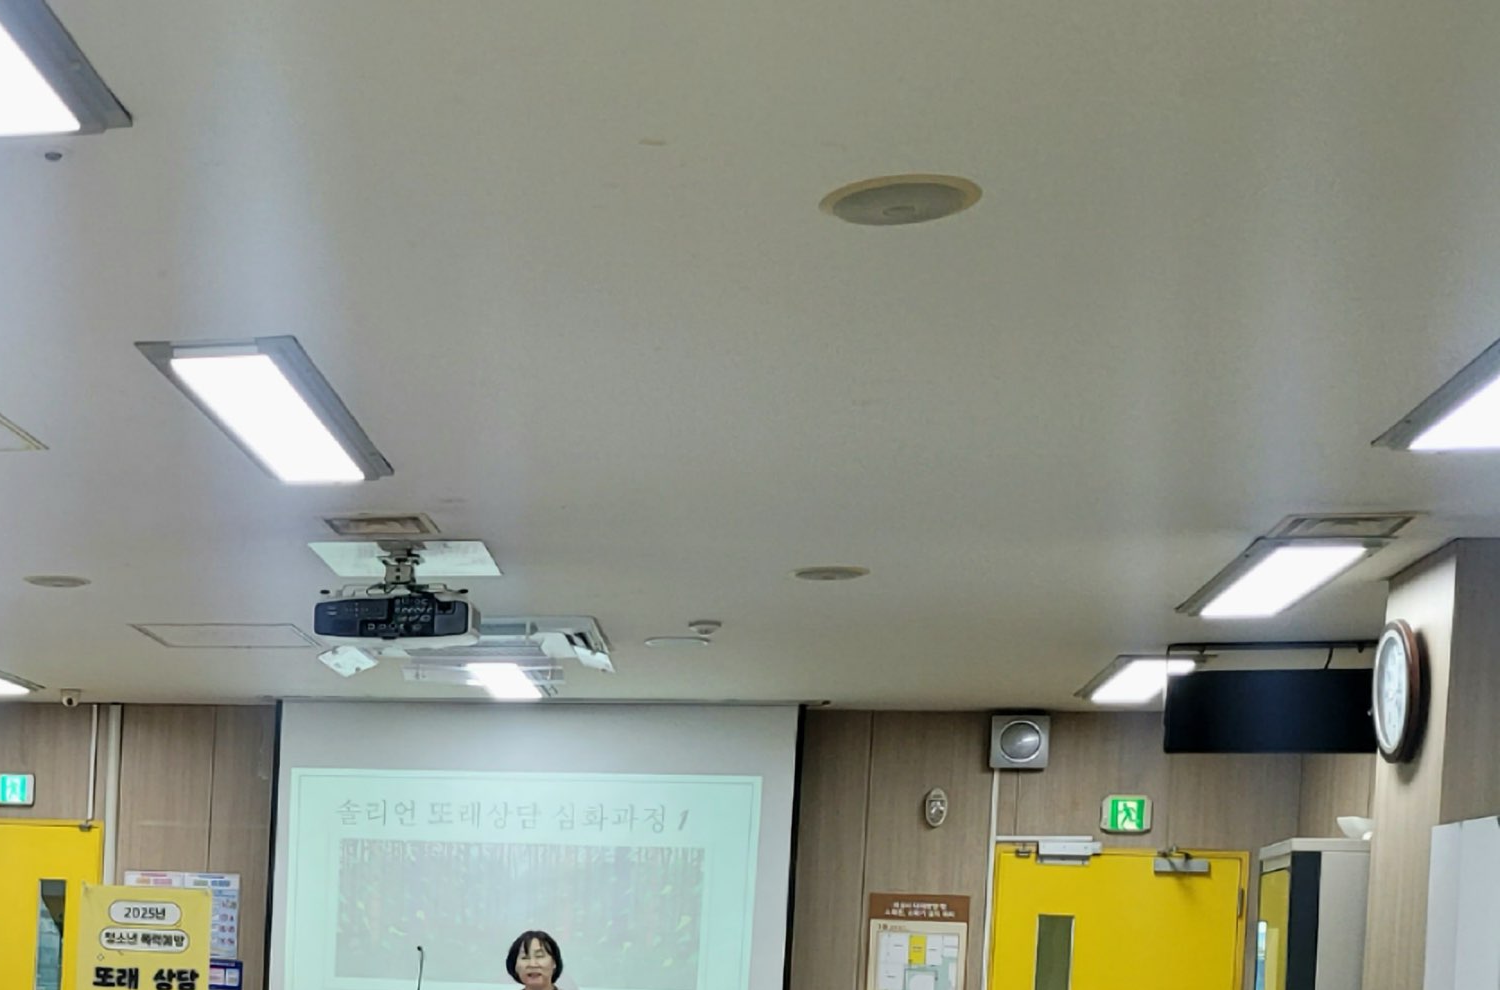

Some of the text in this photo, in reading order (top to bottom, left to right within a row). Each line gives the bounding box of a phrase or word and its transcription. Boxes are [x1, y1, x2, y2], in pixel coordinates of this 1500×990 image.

[337, 799, 417, 827] 솔리언
[428, 801, 542, 831] 또래상담
[556, 802, 667, 834] 심화과정
[124, 906, 166, 921] 2025년
[104, 931, 138, 945] 청소년
[93, 966, 139, 990] 또래
